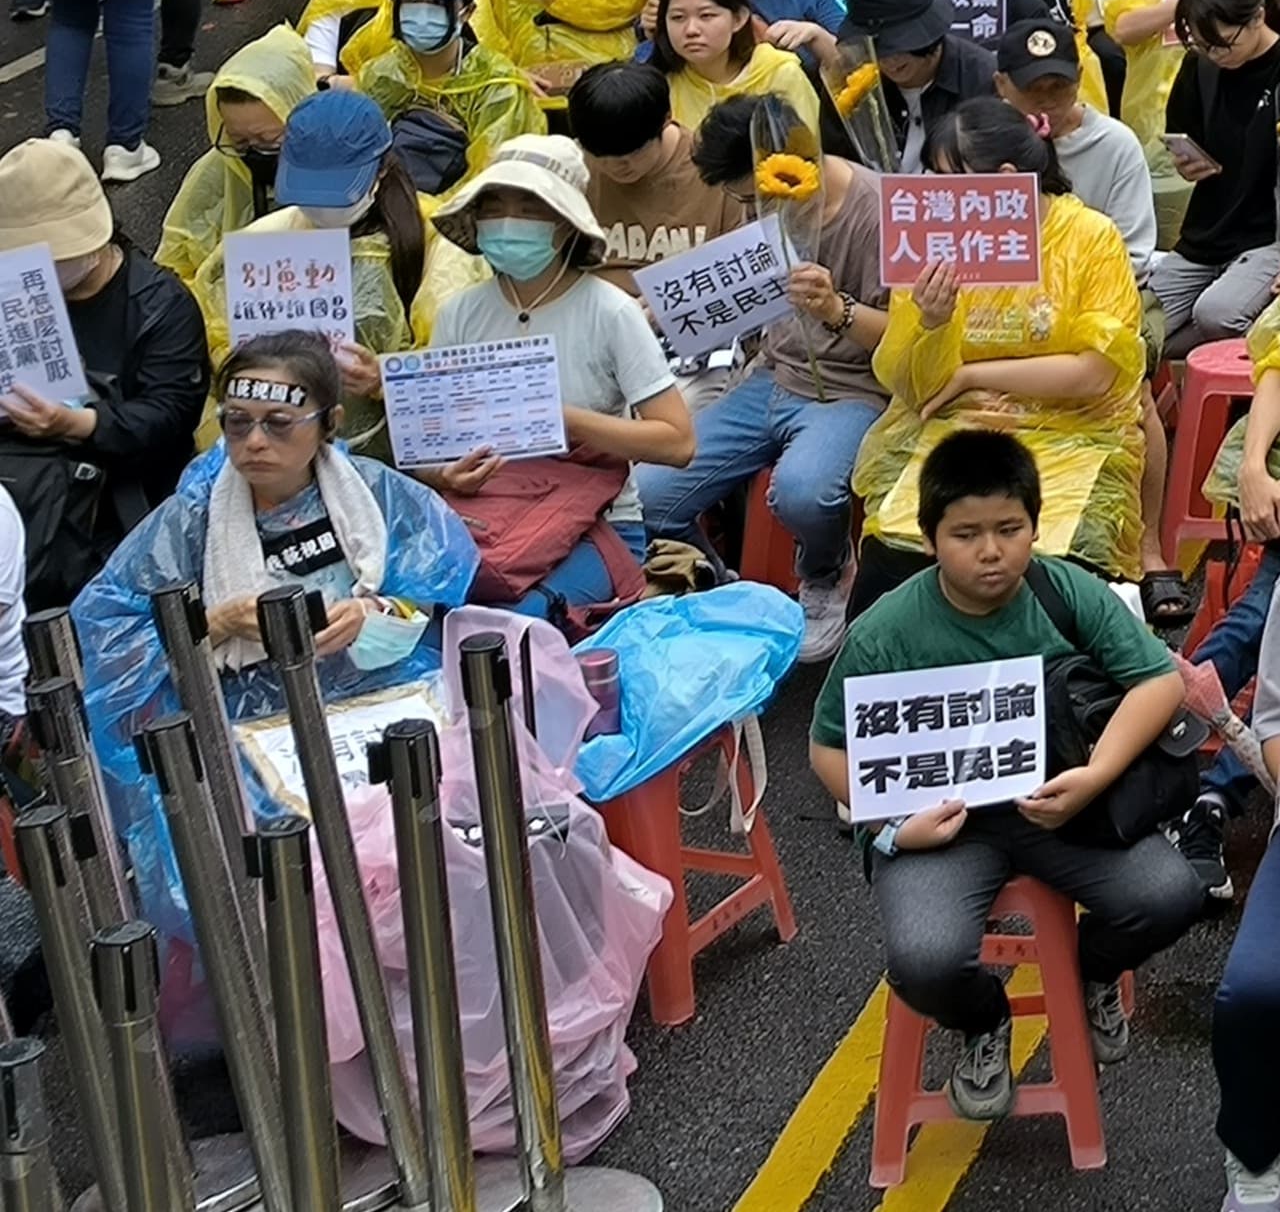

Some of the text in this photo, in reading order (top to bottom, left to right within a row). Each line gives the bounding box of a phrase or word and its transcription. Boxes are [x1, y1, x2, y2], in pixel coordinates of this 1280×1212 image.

[889, 189, 1030, 224] 台灣內政
[889, 227, 1031, 264] 人民作主
[653, 241, 779, 312] 沒有討論
[670, 275, 787, 338] 不是民主
[1, 298, 41, 366] 民進黨
[20, 269, 75, 384] 再怎麼討厭
[855, 683, 1038, 740] 沒有討論
[858, 738, 1038, 795] 不是民主
